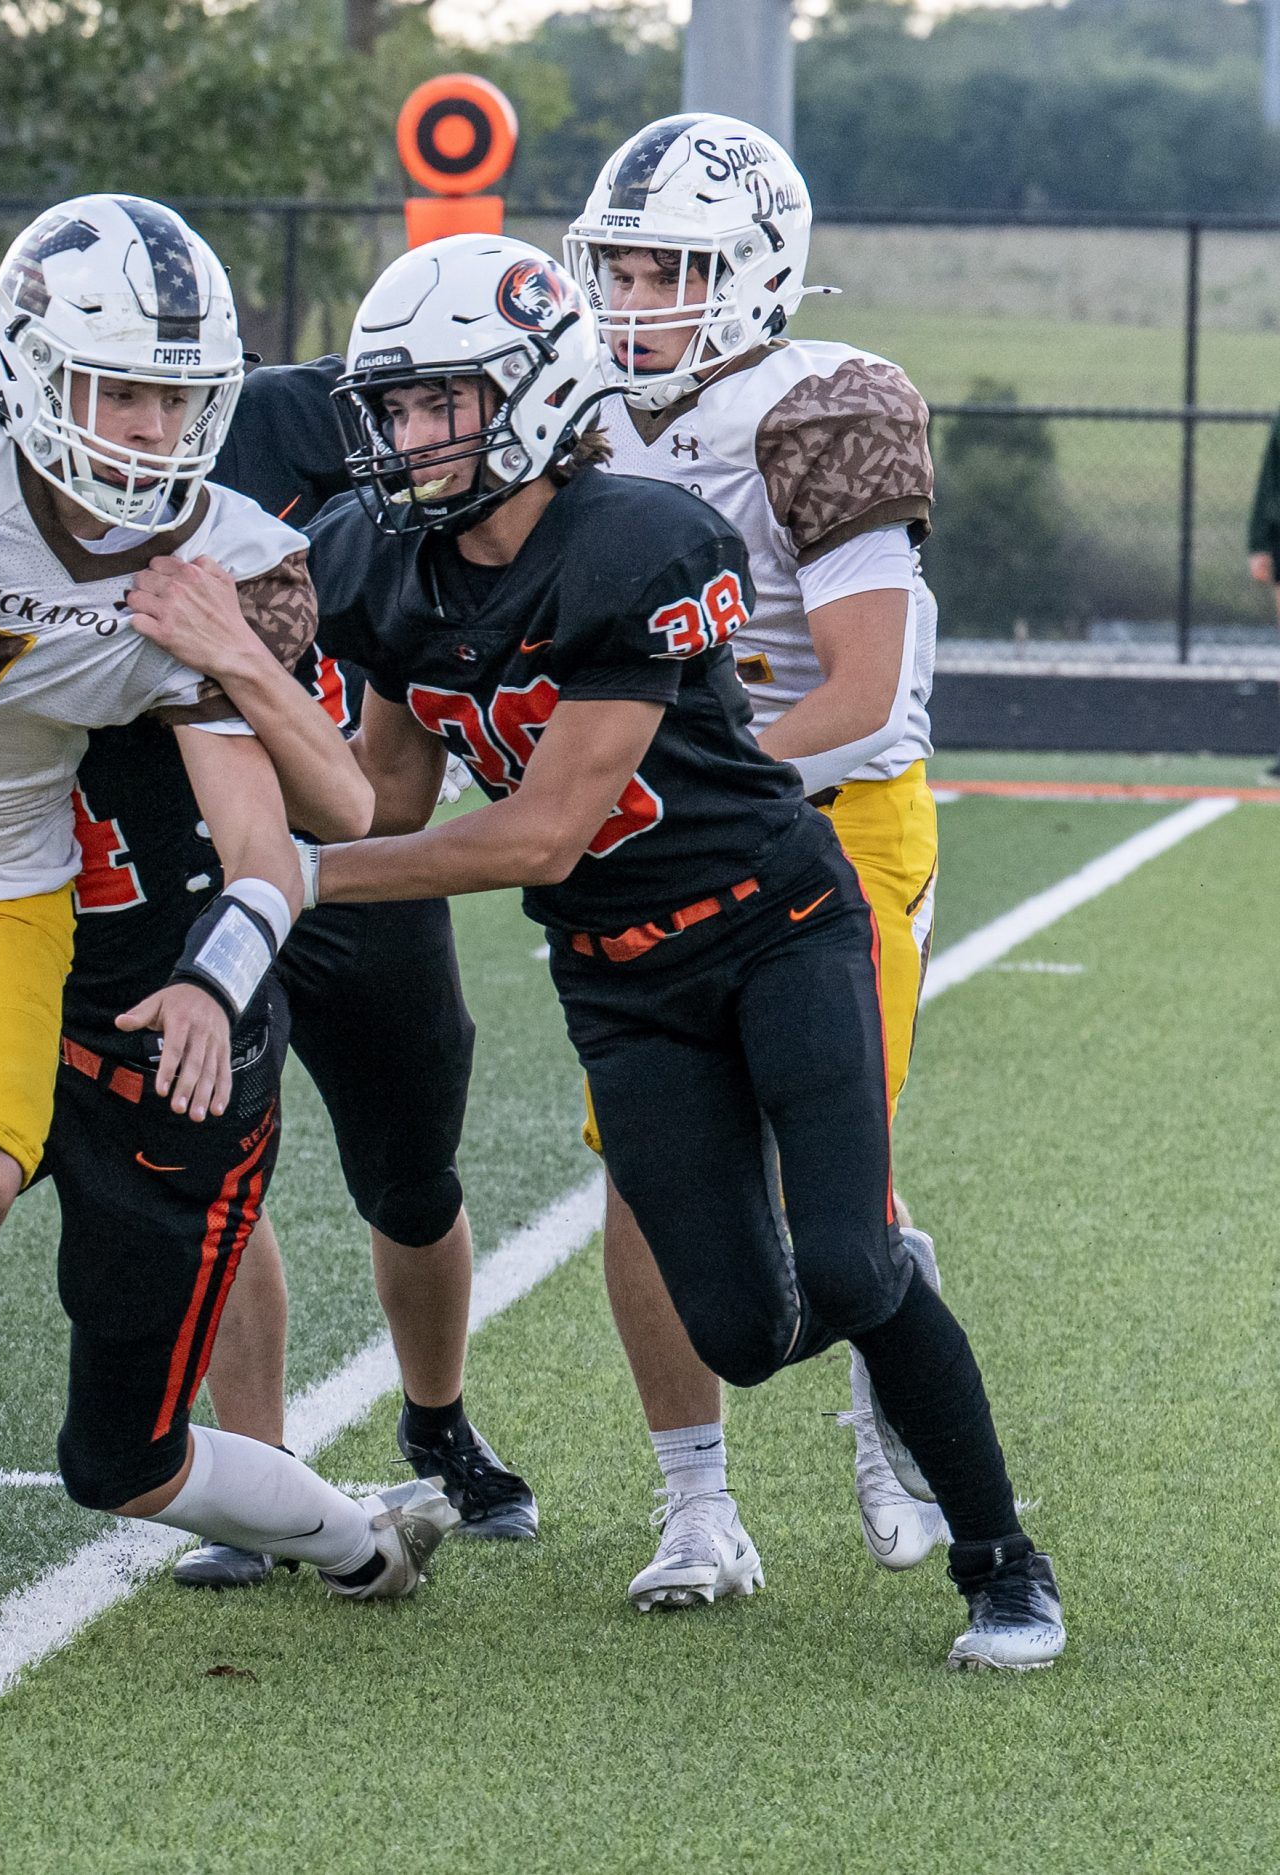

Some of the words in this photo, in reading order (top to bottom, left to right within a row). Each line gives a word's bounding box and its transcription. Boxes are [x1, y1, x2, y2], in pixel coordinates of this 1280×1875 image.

[600, 213, 641, 229] CHIEFS
[153, 347, 201, 366] CHIEFS
[182, 401, 219, 447] Riddell
[647, 569, 751, 660] 38
